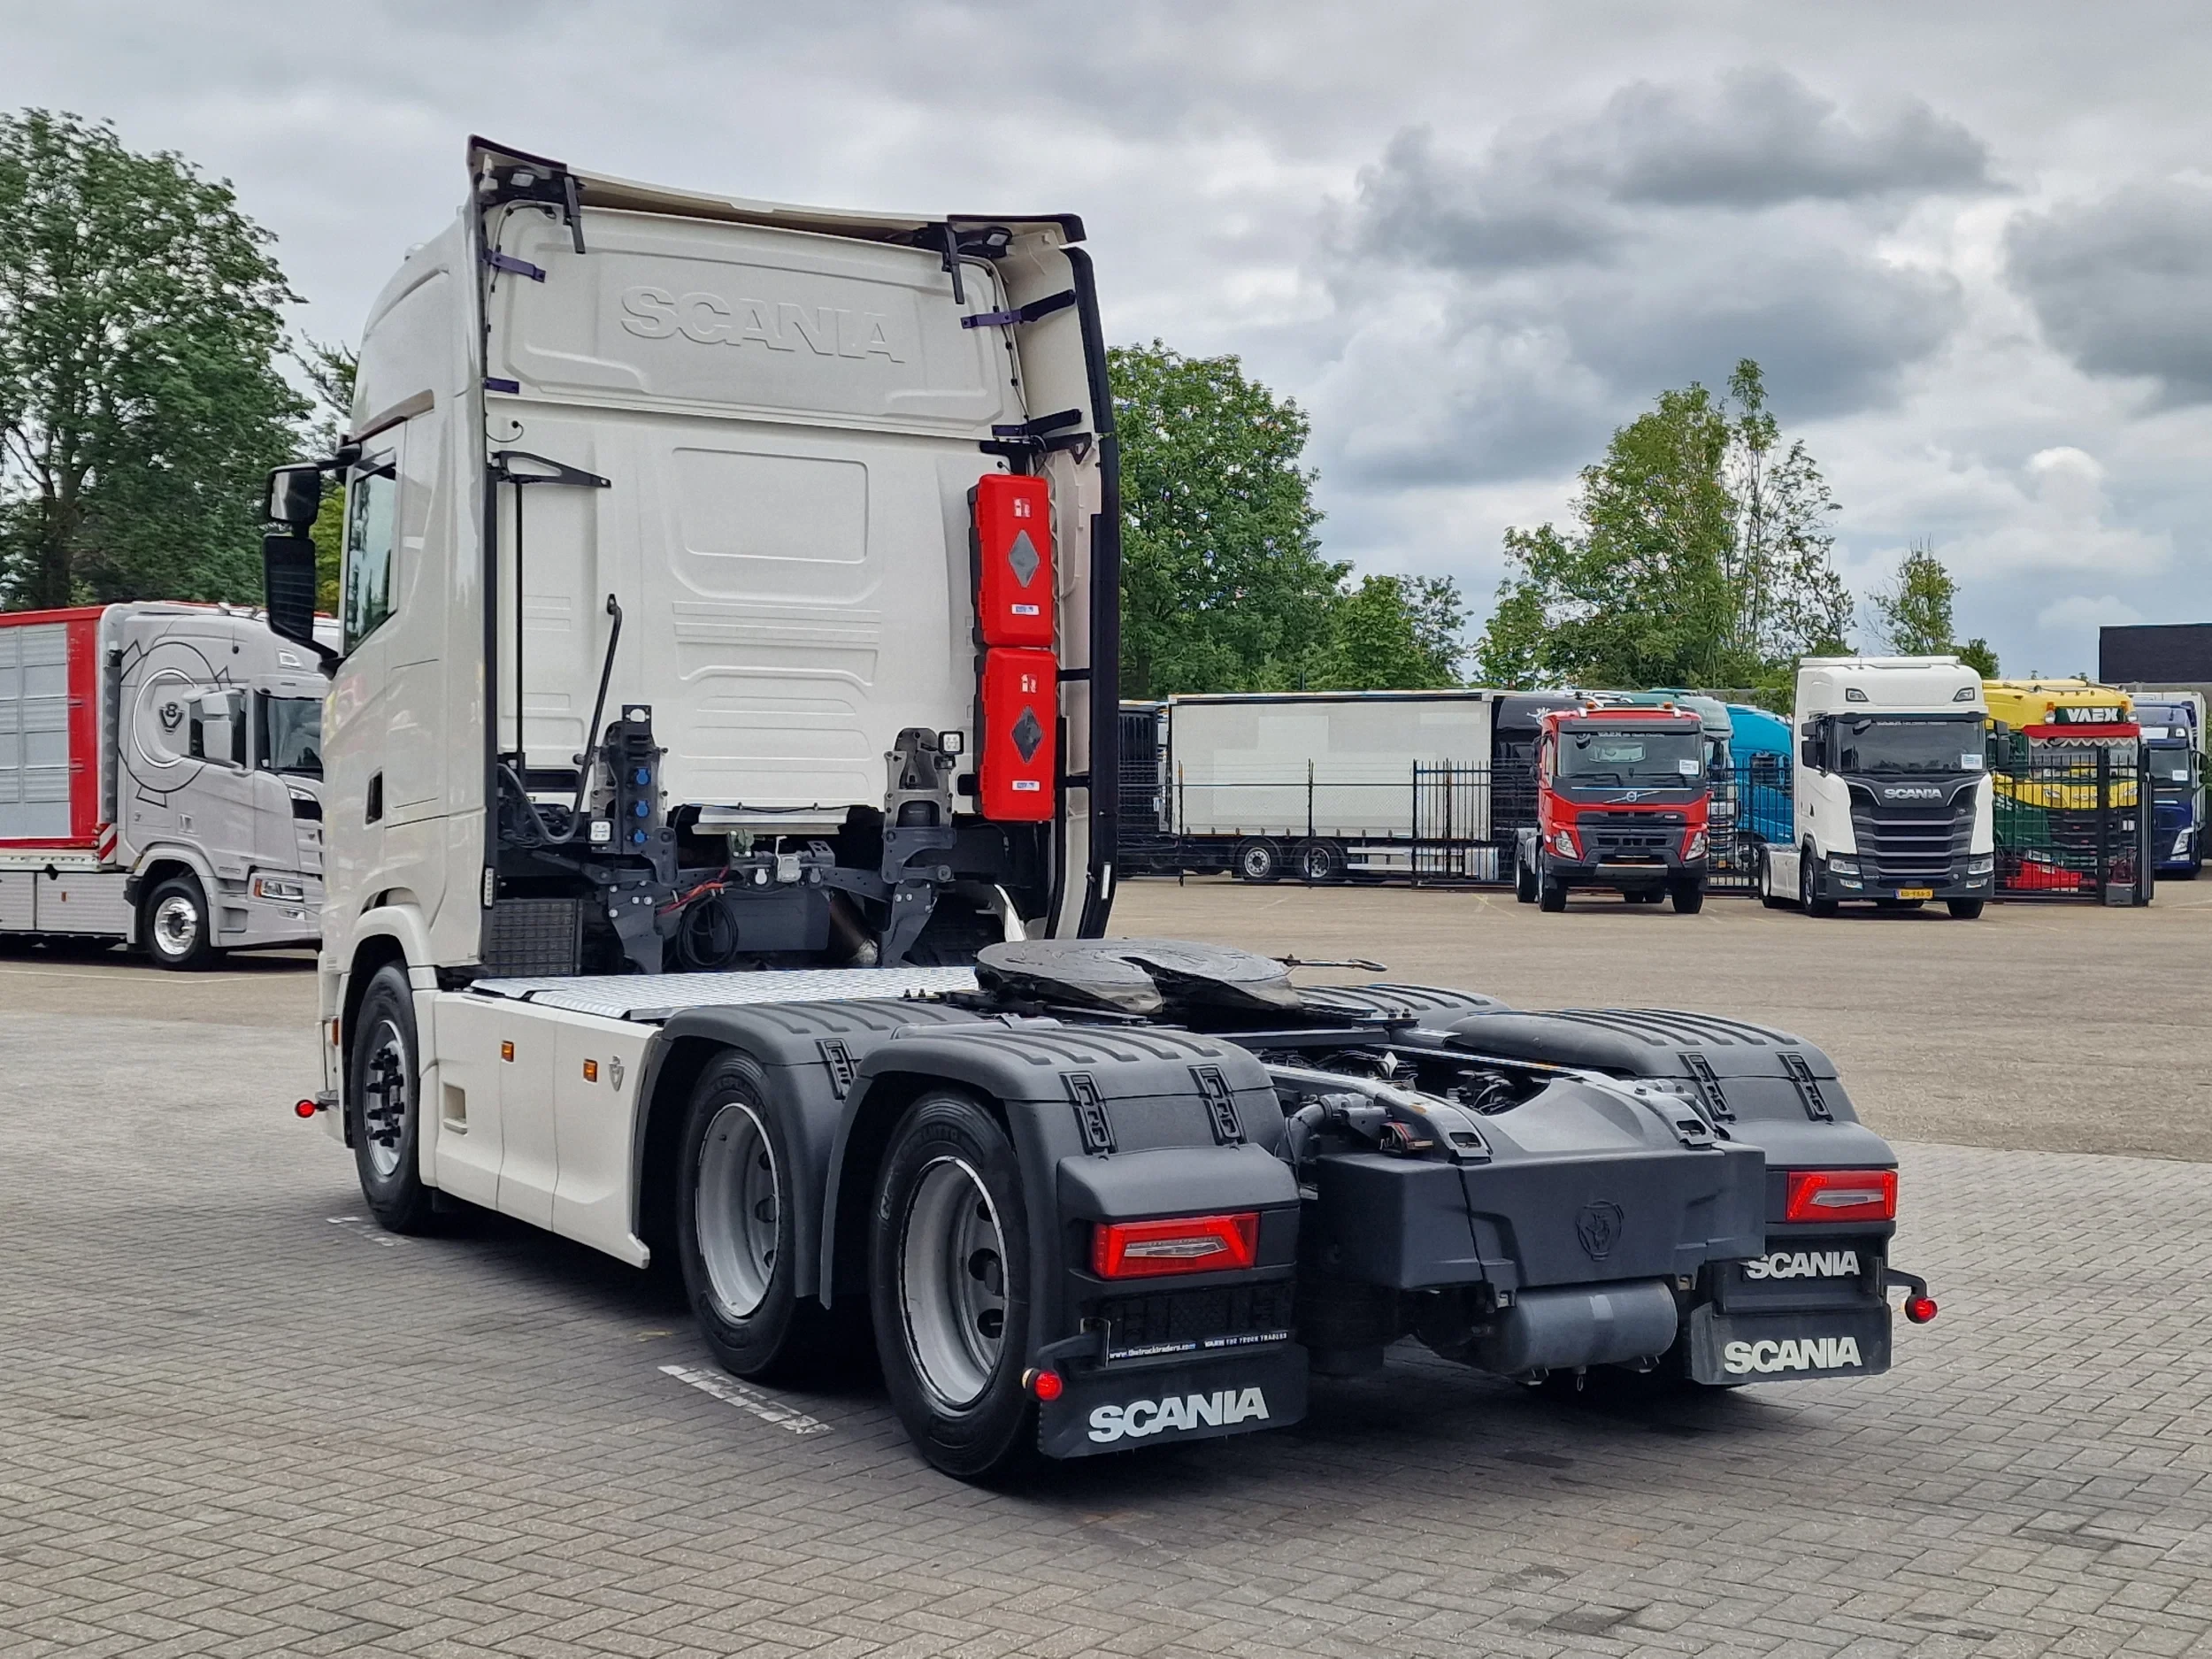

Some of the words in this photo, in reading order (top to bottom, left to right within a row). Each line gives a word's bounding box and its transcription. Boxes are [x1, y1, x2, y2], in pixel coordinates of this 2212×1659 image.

[621, 286, 905, 364] SCANIA
[2067, 708, 2118, 722] VAEX
[1884, 788, 1943, 799] SCANIA
[1746, 1250, 1861, 1279] SCANIA
[1724, 1336, 1863, 1374] SCANIA
[1087, 1386, 1270, 1443] SCANIA
